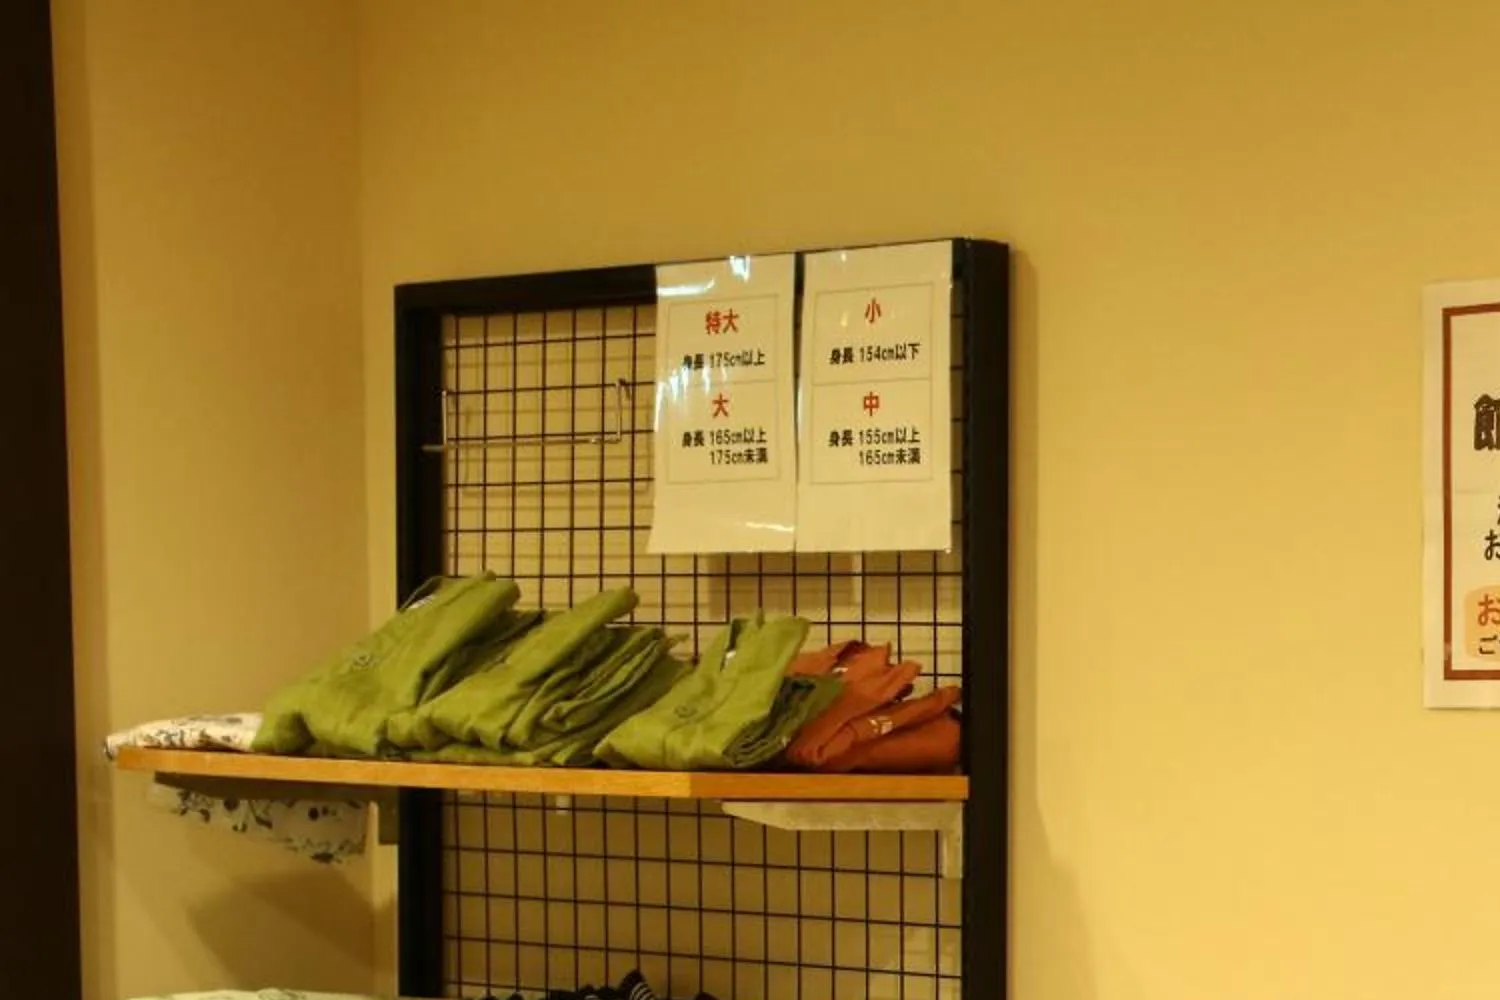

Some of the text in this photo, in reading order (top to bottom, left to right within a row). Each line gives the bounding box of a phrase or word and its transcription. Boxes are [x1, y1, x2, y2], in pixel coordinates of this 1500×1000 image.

[704, 308, 739, 335] 特大
[864, 298, 882, 324] 小
[712, 393, 729, 418] 大
[863, 391, 880, 417] 中
